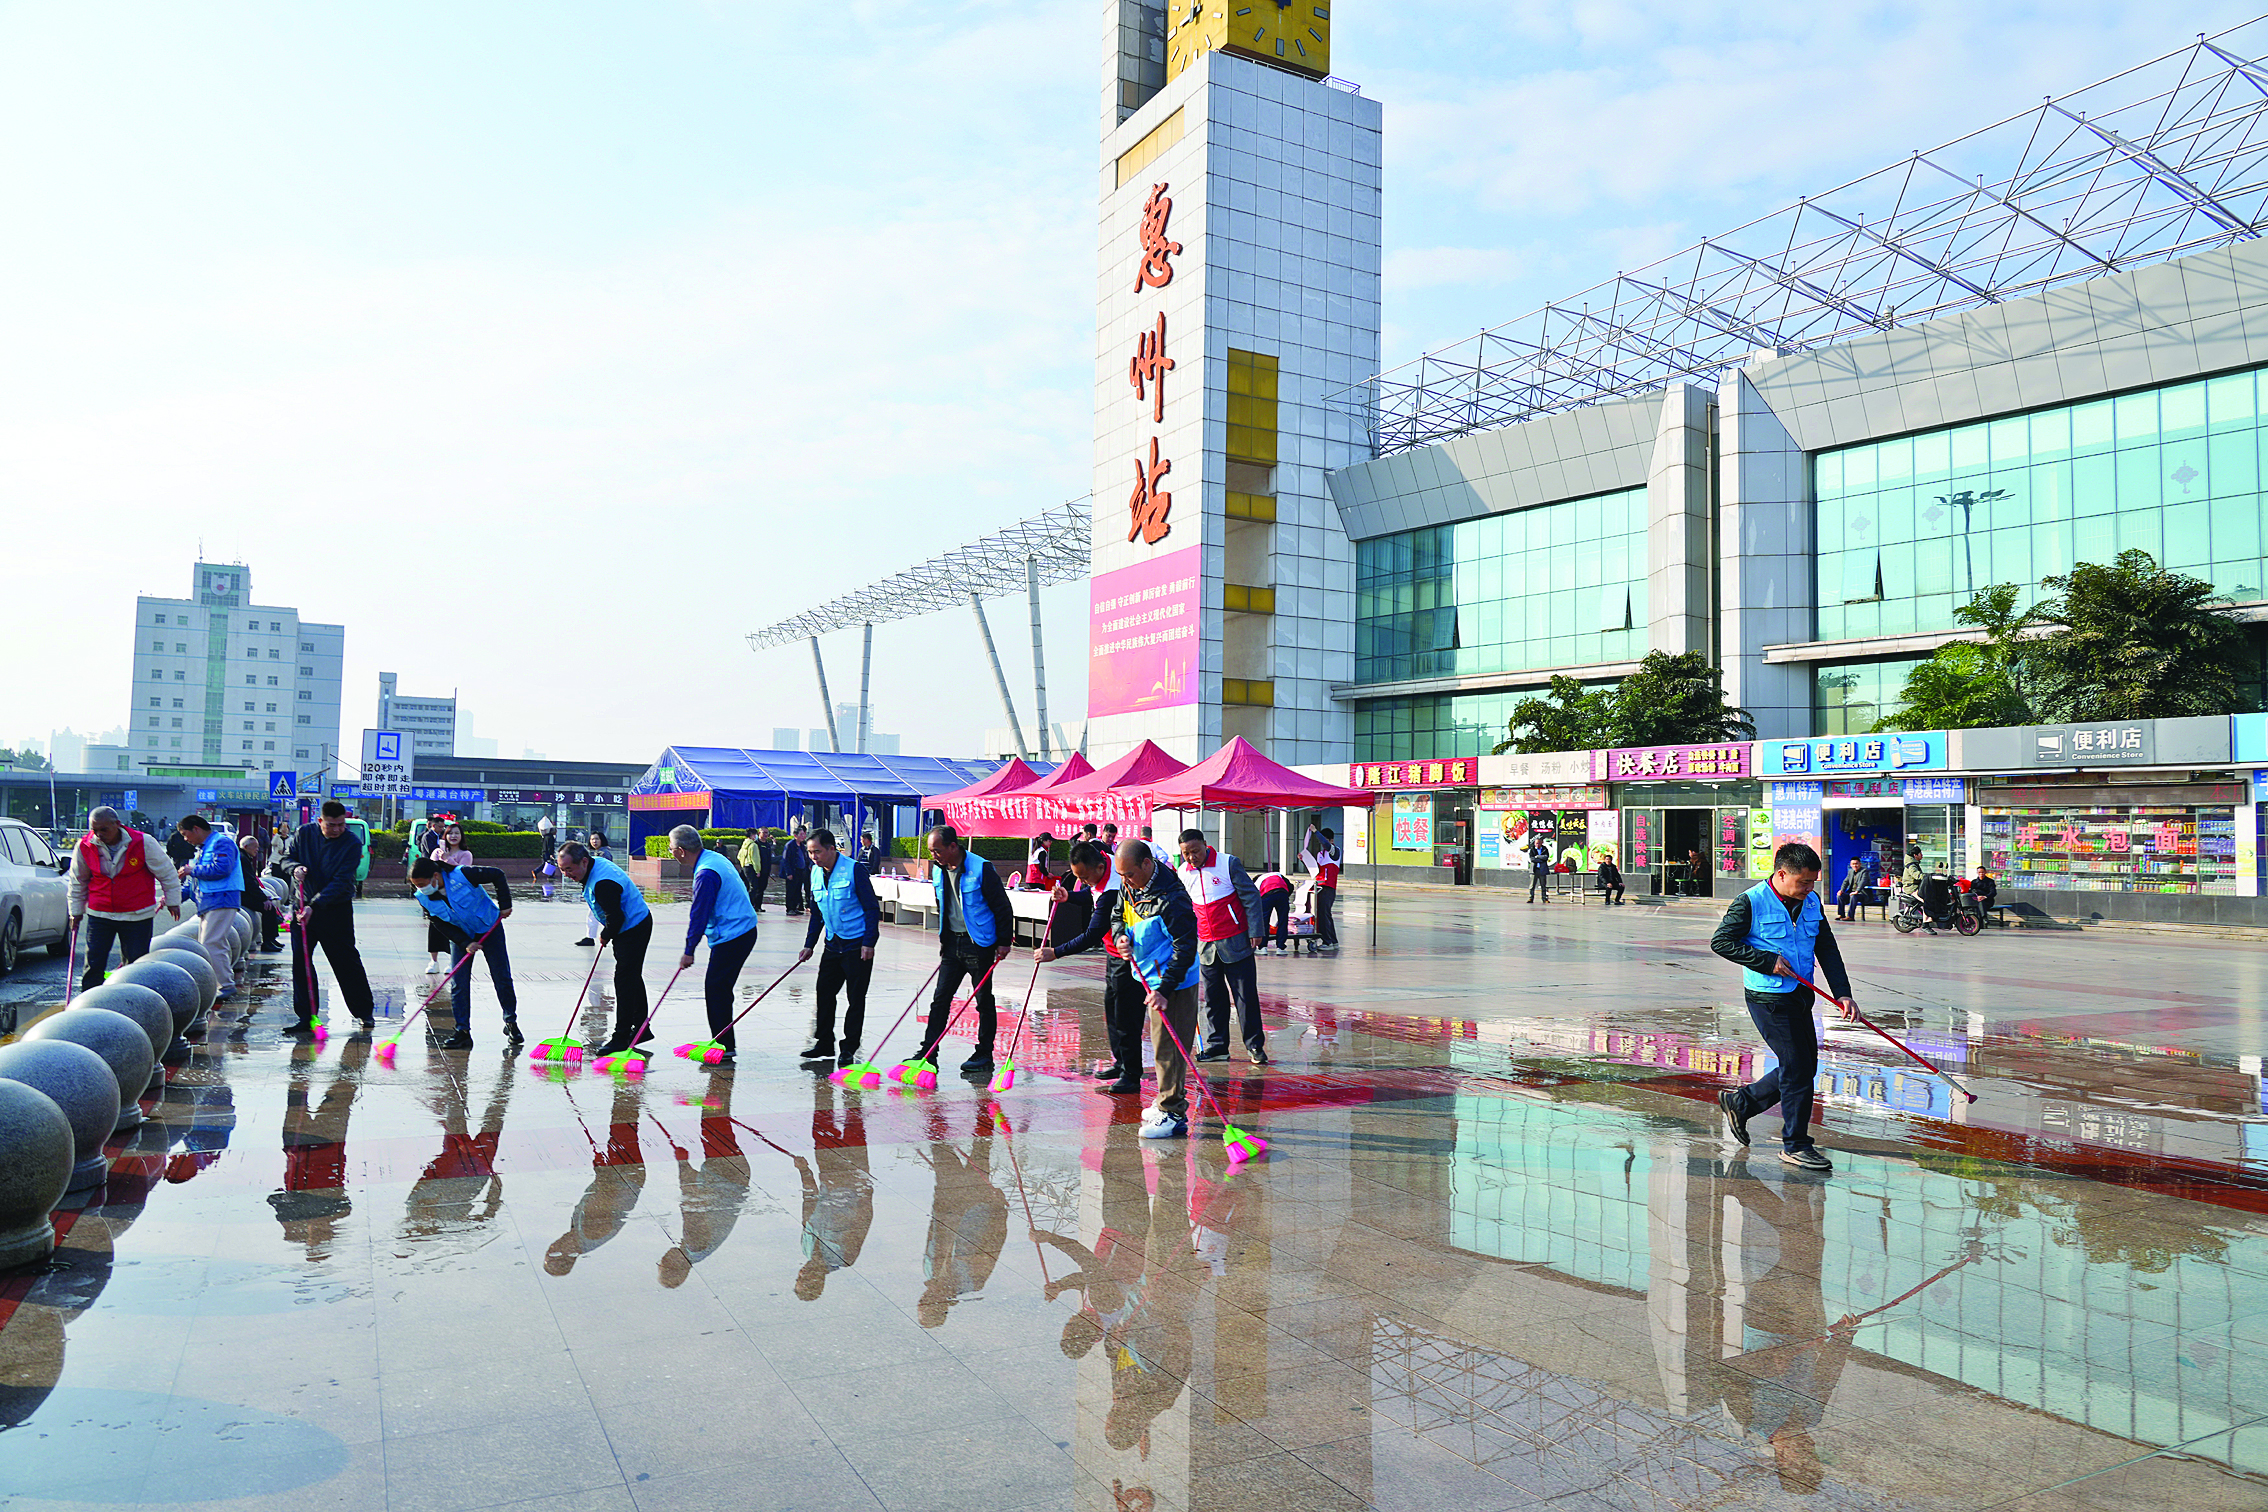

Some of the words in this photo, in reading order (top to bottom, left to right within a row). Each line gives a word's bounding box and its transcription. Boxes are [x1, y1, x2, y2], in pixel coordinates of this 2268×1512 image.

[1128, 182, 1183, 545] 惠州站
[1117, 591, 1142, 609] 守正创新
[1101, 602, 1186, 635] 为全面建设社会主义现代化国家
[1093, 623, 1195, 658] 全面推进中华民族伟大复兴而团结奋斗
[2072, 728, 2142, 751] 便利店
[1815, 740, 1883, 762] 便利店
[2071, 752, 2121, 760] Convenience
[2121, 751, 2144, 759] Store
[363, 763, 404, 772] 120秒内
[1368, 761, 1466, 785] 隆江猪脚饭
[1509, 762, 1530, 776] 早餐
[1541, 760, 1561, 775] 汤粉
[1569, 760, 1591, 774] 小炒
[1616, 749, 1680, 776] 快餐店
[1821, 762, 1858, 770] Convenience
[1858, 761, 1876, 769] Store
[362, 773, 411, 783] 即停即走
[362, 783, 410, 792] 超时抓拍
[1854, 781, 1899, 795] 便利店
[198, 790, 216, 801] 住宿
[1774, 782, 1819, 801] 惠州特产
[1905, 779, 1961, 800] 粤港澳台特产
[1395, 817, 1430, 843] 快餐
[1773, 808, 1820, 830] 粤港澳台特产
[1635, 814, 1647, 868] 自选快餐
[1722, 815, 1736, 872] 空调开放
[2015, 825, 2180, 853] 开水泡面
